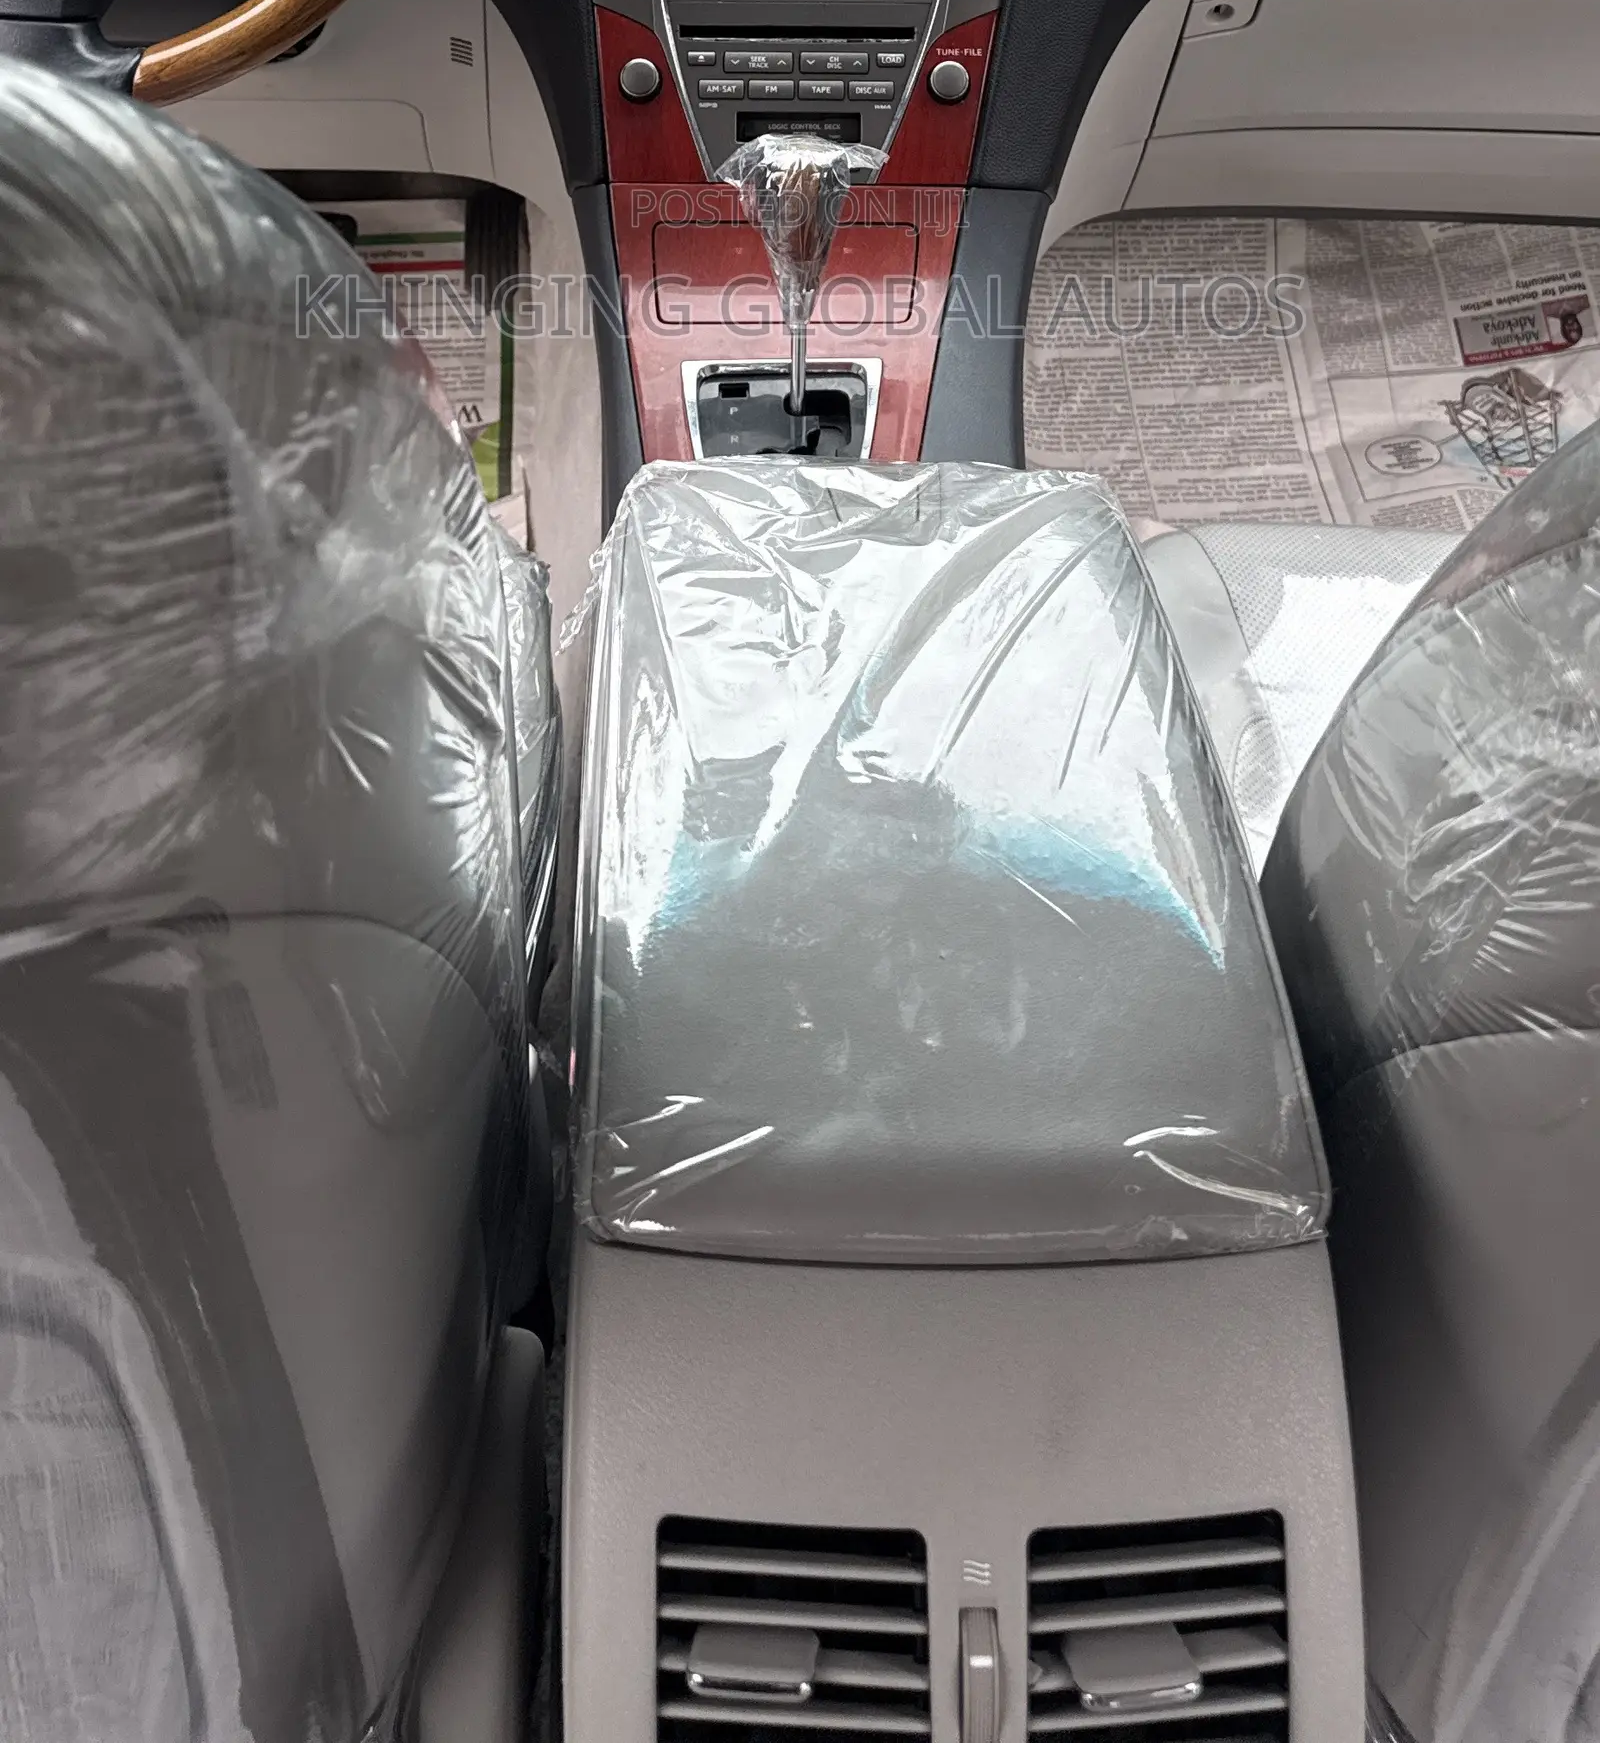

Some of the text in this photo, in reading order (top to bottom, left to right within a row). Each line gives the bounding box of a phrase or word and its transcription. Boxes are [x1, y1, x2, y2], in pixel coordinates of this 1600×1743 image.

[881, 56, 902, 64] LOAD
[748, 61, 769, 69] TRACK
[765, 85, 778, 94] FM
[811, 86, 831, 94] TAPE
[1541, 287, 1556, 297] for
[729, 406, 739, 415] P
[730, 434, 739, 444] R
